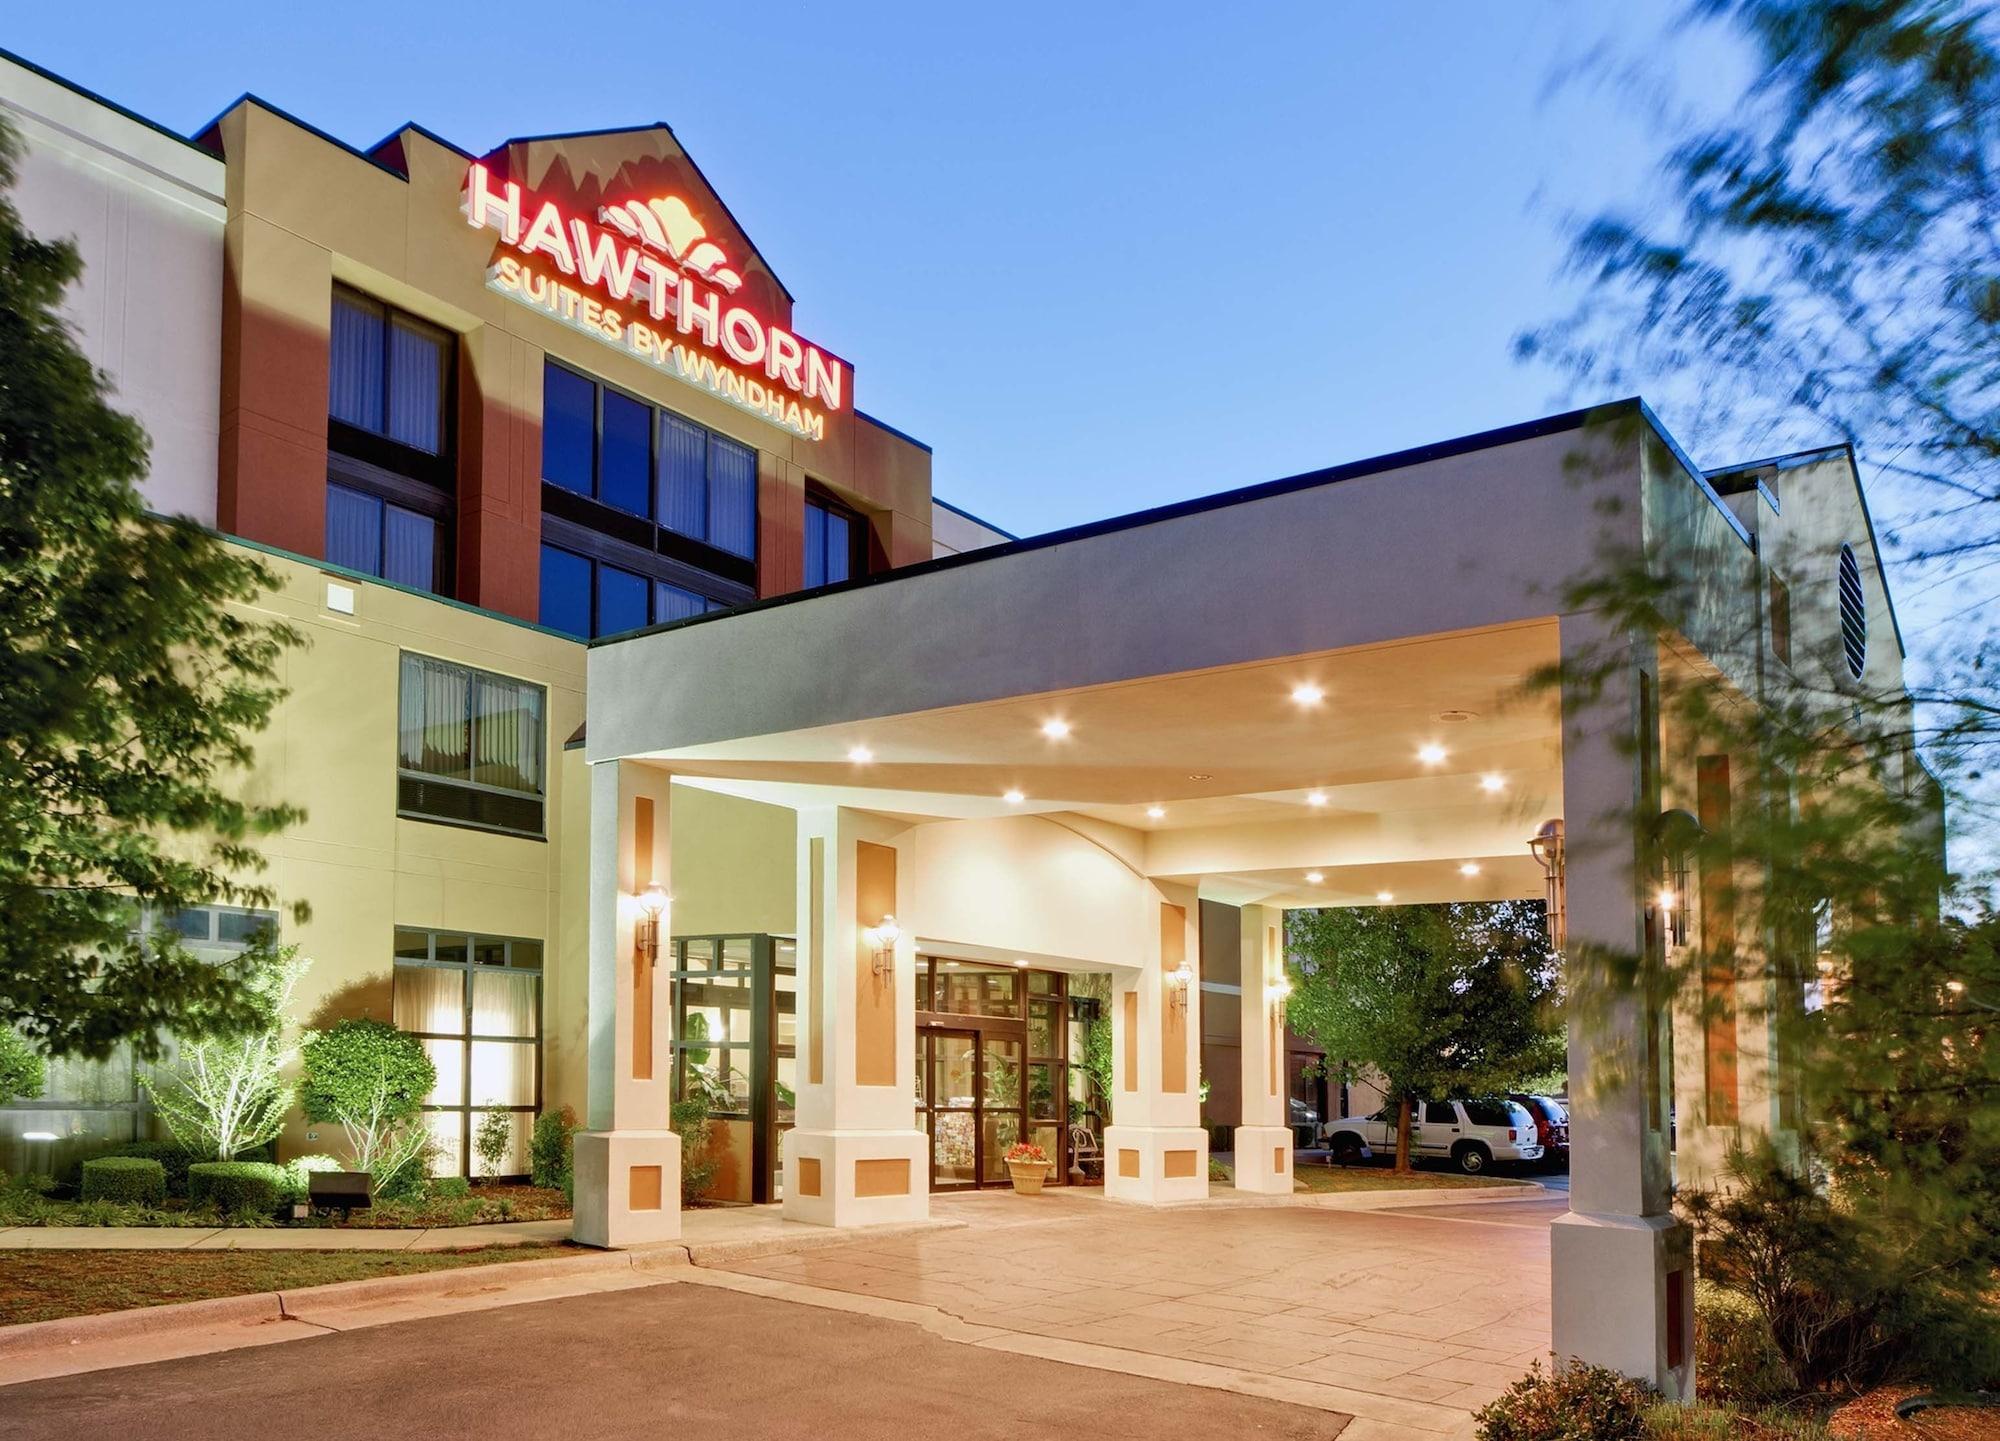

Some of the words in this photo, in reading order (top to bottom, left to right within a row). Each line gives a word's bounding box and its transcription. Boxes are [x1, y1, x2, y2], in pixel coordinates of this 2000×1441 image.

[467, 162, 842, 411] HAWTHORN
[498, 254, 624, 343] SUITES
[628, 321, 672, 366] BY
[673, 342, 824, 442] WYNDHAM
